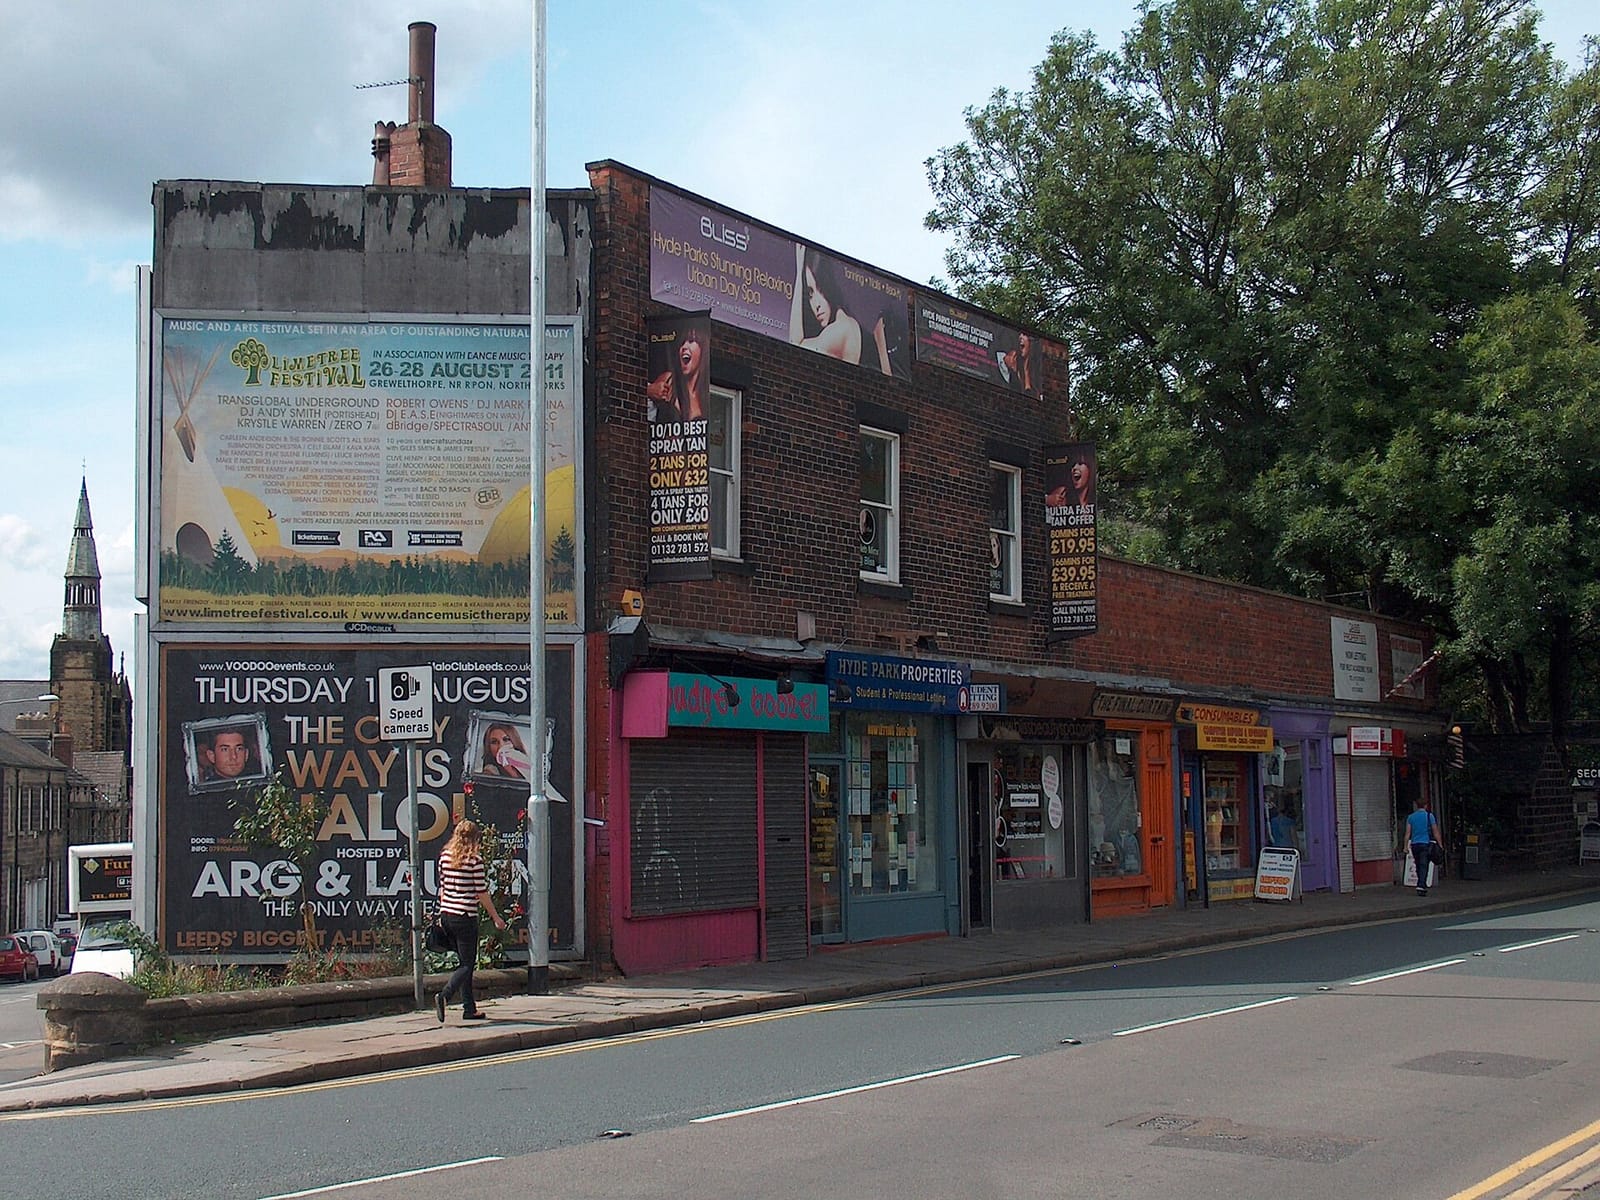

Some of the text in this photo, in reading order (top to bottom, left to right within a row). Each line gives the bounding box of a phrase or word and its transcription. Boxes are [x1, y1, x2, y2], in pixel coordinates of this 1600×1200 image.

[652, 230, 793, 299] Hyde Parks Stunning Relaxing
[687, 264, 761, 304] Urban Day Spa
[169, 321, 204, 332] MUSIC
[207, 322, 231, 332] AND
[234, 323, 258, 333] ARTS
[262, 324, 304, 334] FESTIVAL
[308, 325, 323, 335] SET
[326, 325, 337, 335] IN
[340, 326, 358, 335] AN
[361, 326, 388, 335] AREA
[391, 326, 405, 336] OF
[407, 326, 480, 336] OUTSTANDING
[484, 327, 529, 337] NATURAL
[373, 350, 527, 360] IN ASSOCIATION WITH DANCE MUSIC
[369, 361, 564, 379] 26-28 AUGUST 211
[448, 380, 462, 389] NR
[499, 381, 531, 390] NORTH
[217, 395, 379, 408] TRANSGLOBAL UNDERGROUND
[386, 399, 524, 410] ROBERT OWENS DJ MARK
[240, 408, 254, 417] DJ
[257, 408, 287, 418] ANDY
[289, 409, 321, 418] SMITH
[237, 419, 326, 429] KRYSTLE WARREN
[650, 420, 708, 438] 10/10 BEST
[650, 437, 706, 454] SPRAY TAN
[650, 453, 707, 470] 2 TANS FOR
[650, 469, 708, 488] ONLY £32
[651, 493, 709, 509] 4 TANS FOR
[651, 507, 709, 525] ONLY £60
[1050, 503, 1095, 516] ULTRA FAST
[1051, 514, 1095, 526] TAN OFFER
[651, 534, 666, 543] CALL
[673, 533, 692, 541] BOOK
[693, 532, 709, 541] NOW
[1080, 527, 1095, 537] FOR
[651, 542, 709, 555] 01132 781 572
[1050, 537, 1095, 554] £19.95
[1082, 556, 1095, 565] FOR
[1051, 566, 1096, 582] £39.95
[1059, 582, 1089, 591] RECEIVE
[1089, 582, 1095, 590] A
[163, 607, 348, 619] www.limetreefestival.co.uk
[199, 660, 335, 672] www.VOODOOevents.co.uk
[838, 658, 963, 685] HYDE PARK PROPERTIES
[195, 677, 354, 704] THURSDAY
[855, 685, 881, 699] Student
[881, 687, 887, 698] &
[888, 689, 926, 703] Professional
[390, 707, 423, 721] Speed
[1193, 707, 1253, 724] CONSUMABLES
[286, 715, 344, 744] THE
[384, 721, 429, 735] cameras
[286, 749, 450, 789] WAY IS
[1576, 768, 1600, 778] SEC
[336, 848, 402, 858] HOSTED BY
[192, 859, 352, 898] ARG &
[263, 901, 295, 917] THE
[355, 900, 399, 916] WAY
[176, 930, 238, 948] LEEDS'
